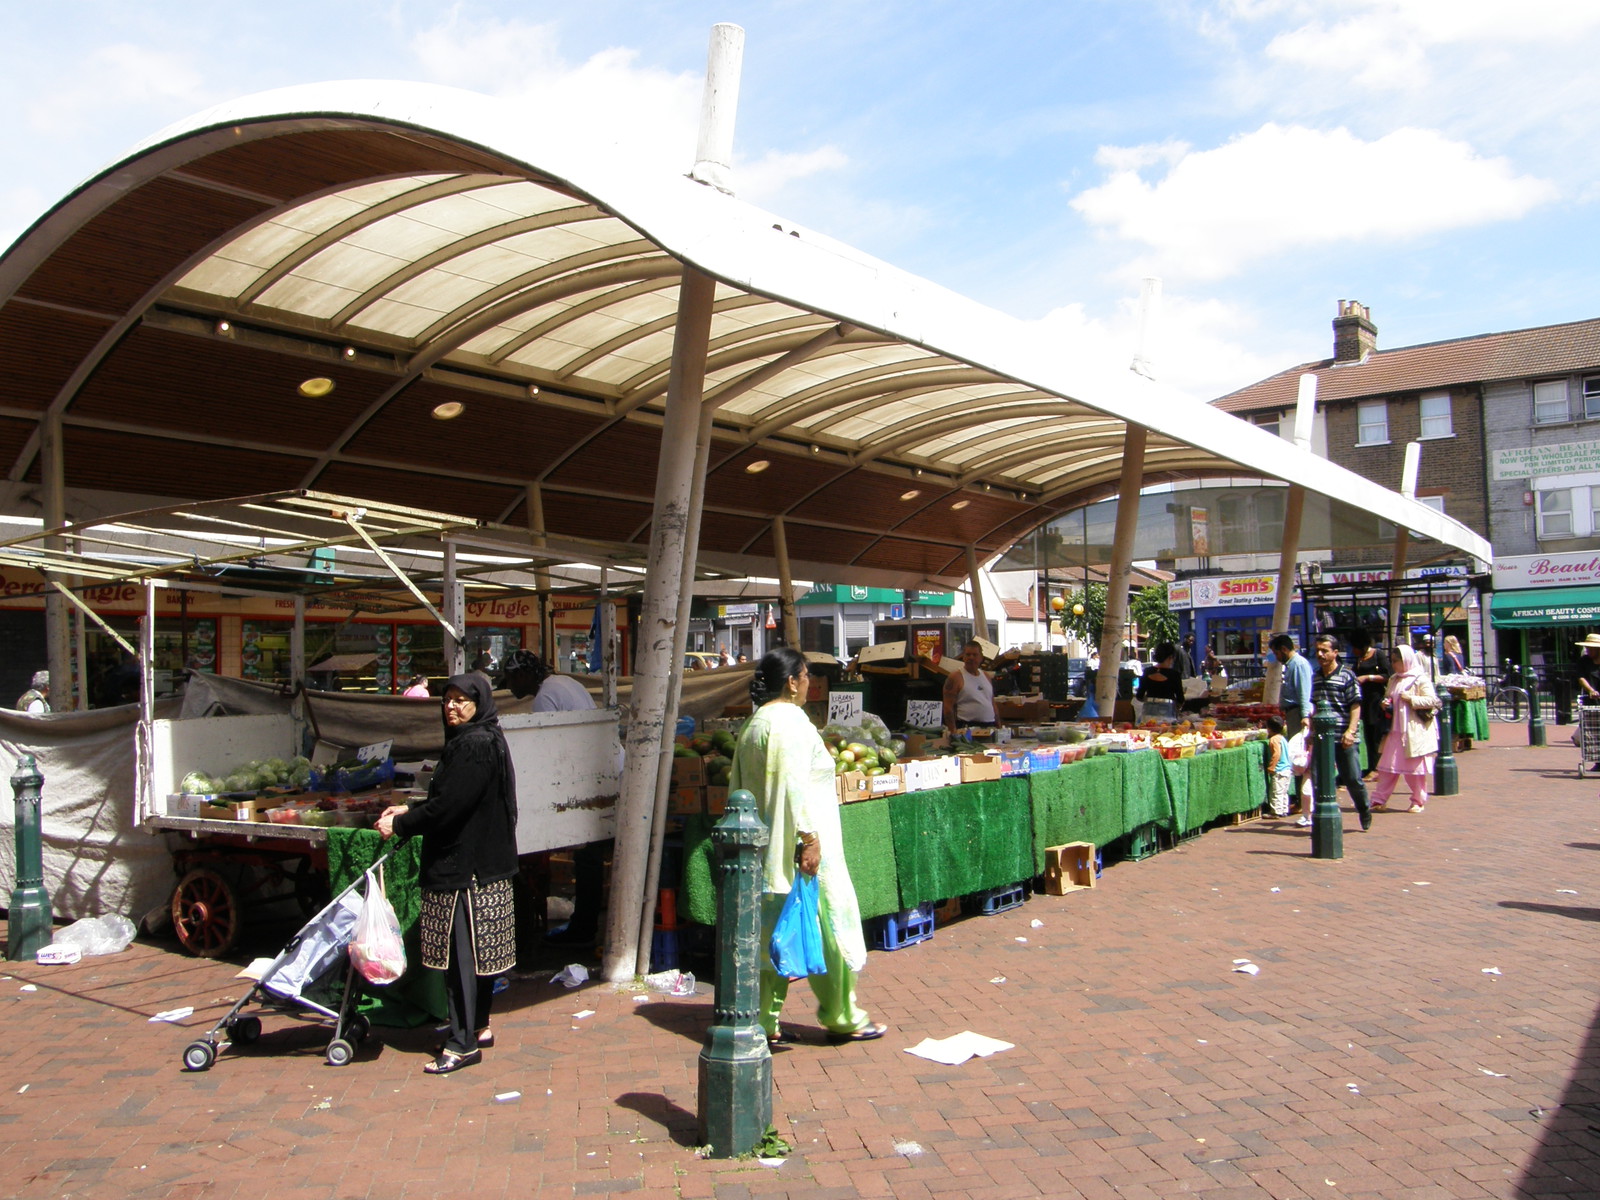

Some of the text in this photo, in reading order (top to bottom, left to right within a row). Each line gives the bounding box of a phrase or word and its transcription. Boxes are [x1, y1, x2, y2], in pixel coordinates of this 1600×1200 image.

[1501, 447, 1551, 457] AFRICAN
[1520, 455, 1539, 463] OPEN
[1542, 449, 1587, 460] WHOLESALE
[1541, 458, 1571, 466] LIMITED
[1500, 469, 1530, 478] SPECIAL
[1532, 466, 1562, 475] OFFERS
[1421, 566, 1461, 576] OMEGA
[1332, 571, 1394, 583] VALENC
[1219, 578, 1270, 595] Sam's
[166, 596, 194, 605] BAKRY
[490, 600, 530, 618] Ingle
[1512, 609, 1544, 617] AFRICAN
[1545, 607, 1575, 615] BEAUTY
